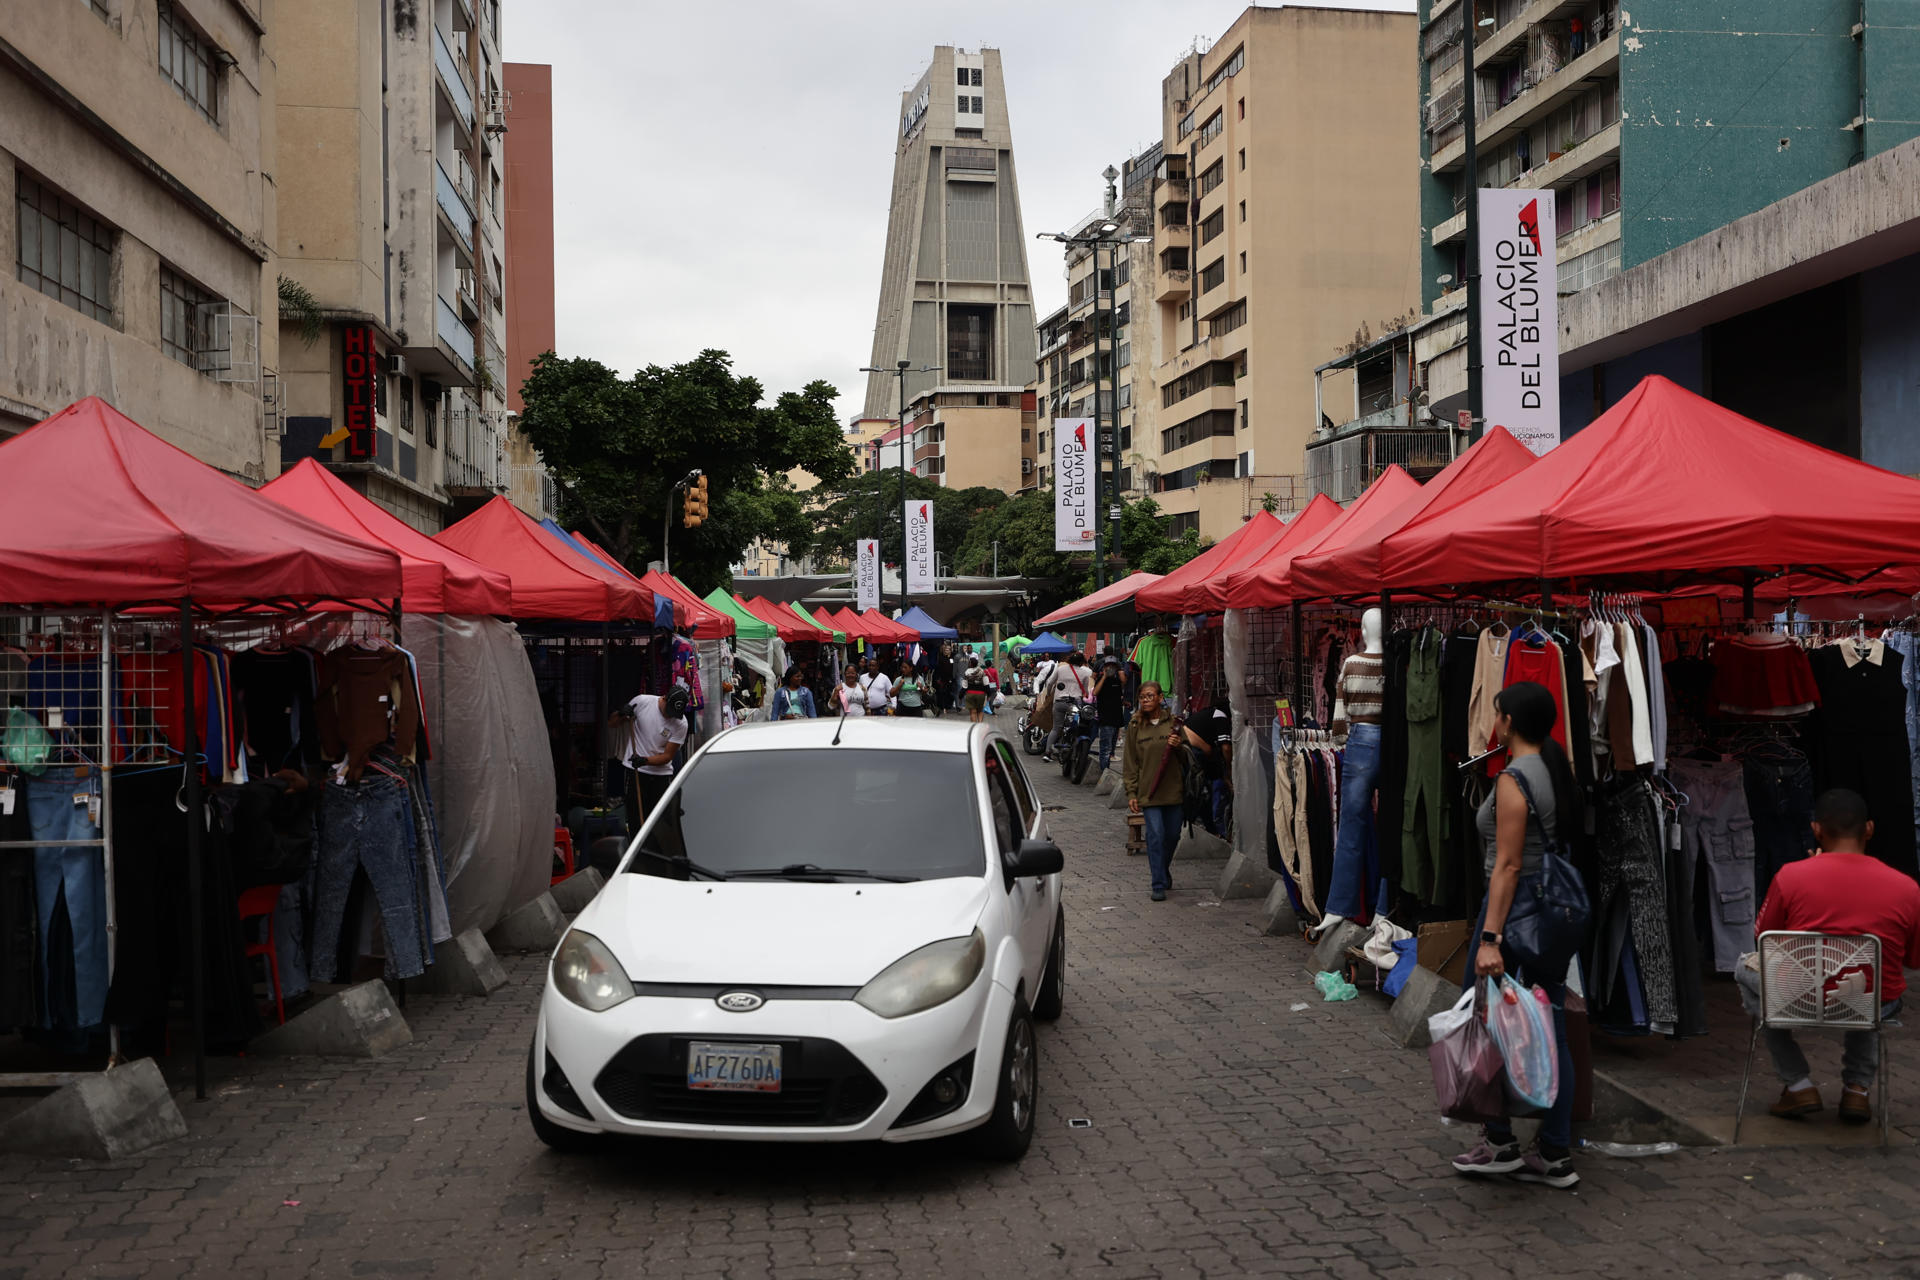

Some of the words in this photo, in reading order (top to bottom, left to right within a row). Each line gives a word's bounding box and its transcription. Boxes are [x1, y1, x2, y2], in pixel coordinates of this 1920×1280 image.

[1496, 240, 1517, 366] PALACIO
[1519, 220, 1540, 343] BLUMER
[345, 328, 367, 456] HOTEL
[1521, 353, 1541, 409] DEL
[1062, 443, 1073, 507] PALACIO
[1074, 434, 1085, 495] BLUMER
[911, 517, 919, 562] PALACIO
[1074, 499, 1085, 528] DEL
[919, 559, 927, 577] DEL
[694, 1055, 775, 1082] AF276DA
